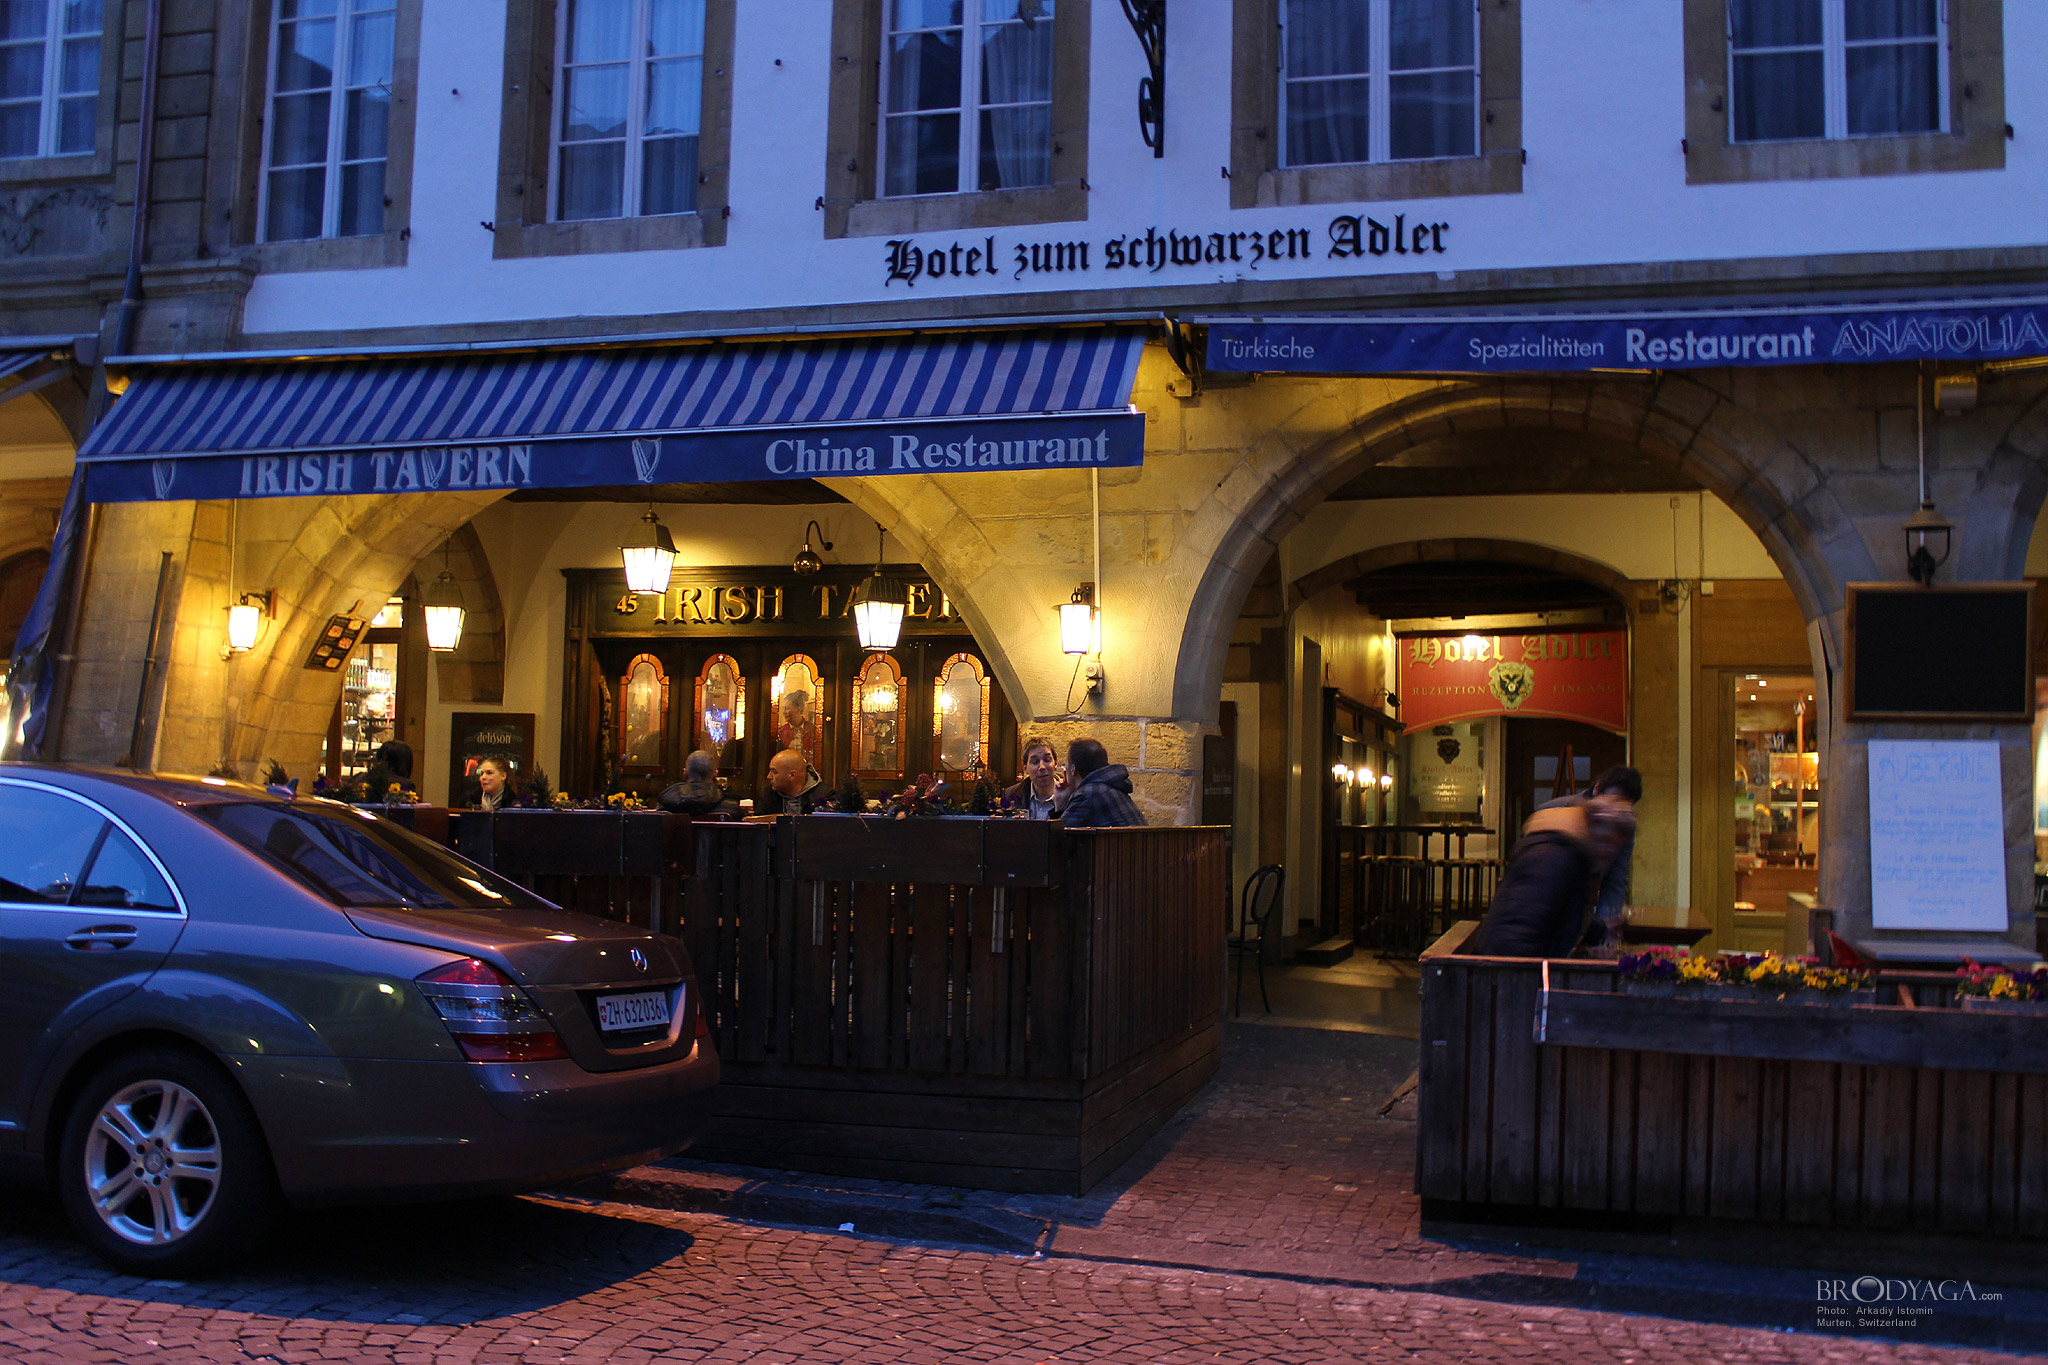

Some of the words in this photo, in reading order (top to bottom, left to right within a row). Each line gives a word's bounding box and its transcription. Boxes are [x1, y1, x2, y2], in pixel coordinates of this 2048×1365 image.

[884, 235, 999, 287] Hotel
[1013, 240, 1090, 280] zum
[1105, 226, 1311, 273] schwarzen
[1327, 213, 1449, 259] Adler
[1222, 336, 1315, 359] Türkische
[1469, 334, 1604, 364] Spezialitäten
[1626, 325, 1815, 363] Restaurant
[1832, 311, 2048, 357] ANATOLIA
[239, 454, 354, 495] IRISH
[370, 445, 534, 490] TAVERN
[765, 438, 876, 474] China
[889, 429, 1109, 469] Restaurant
[616, 594, 639, 614] 45
[653, 585, 784, 622] IRISH
[1409, 635, 1505, 669] Hotel
[1521, 634, 1616, 662] Adler
[1413, 686, 1487, 696] REZEPTION
[1553, 684, 1617, 694] EINGANG
[1878, 744, 1992, 783] AUBERGINE
